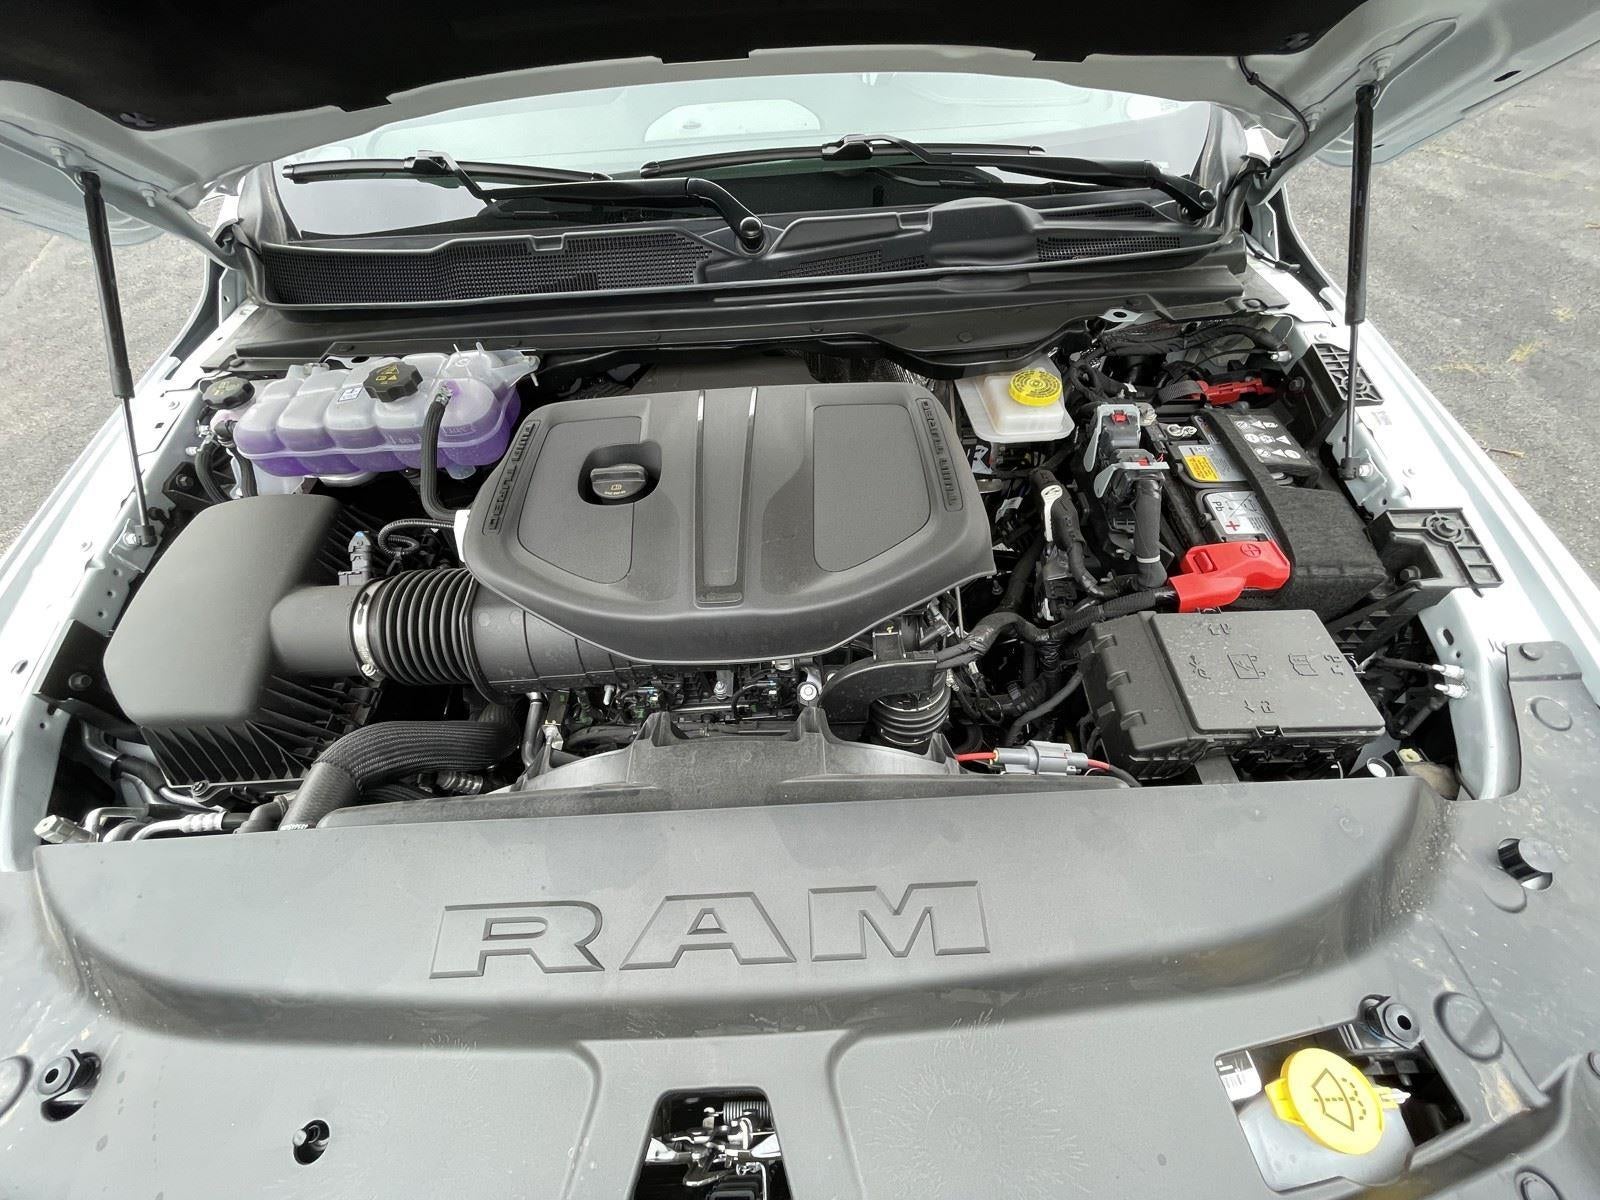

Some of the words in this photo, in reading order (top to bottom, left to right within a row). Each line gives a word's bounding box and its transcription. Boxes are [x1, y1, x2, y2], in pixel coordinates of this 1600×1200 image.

[488, 464, 518, 531] TURBO
[1212, 501, 1224, 512] Pb
[429, 880, 991, 979] RAM
